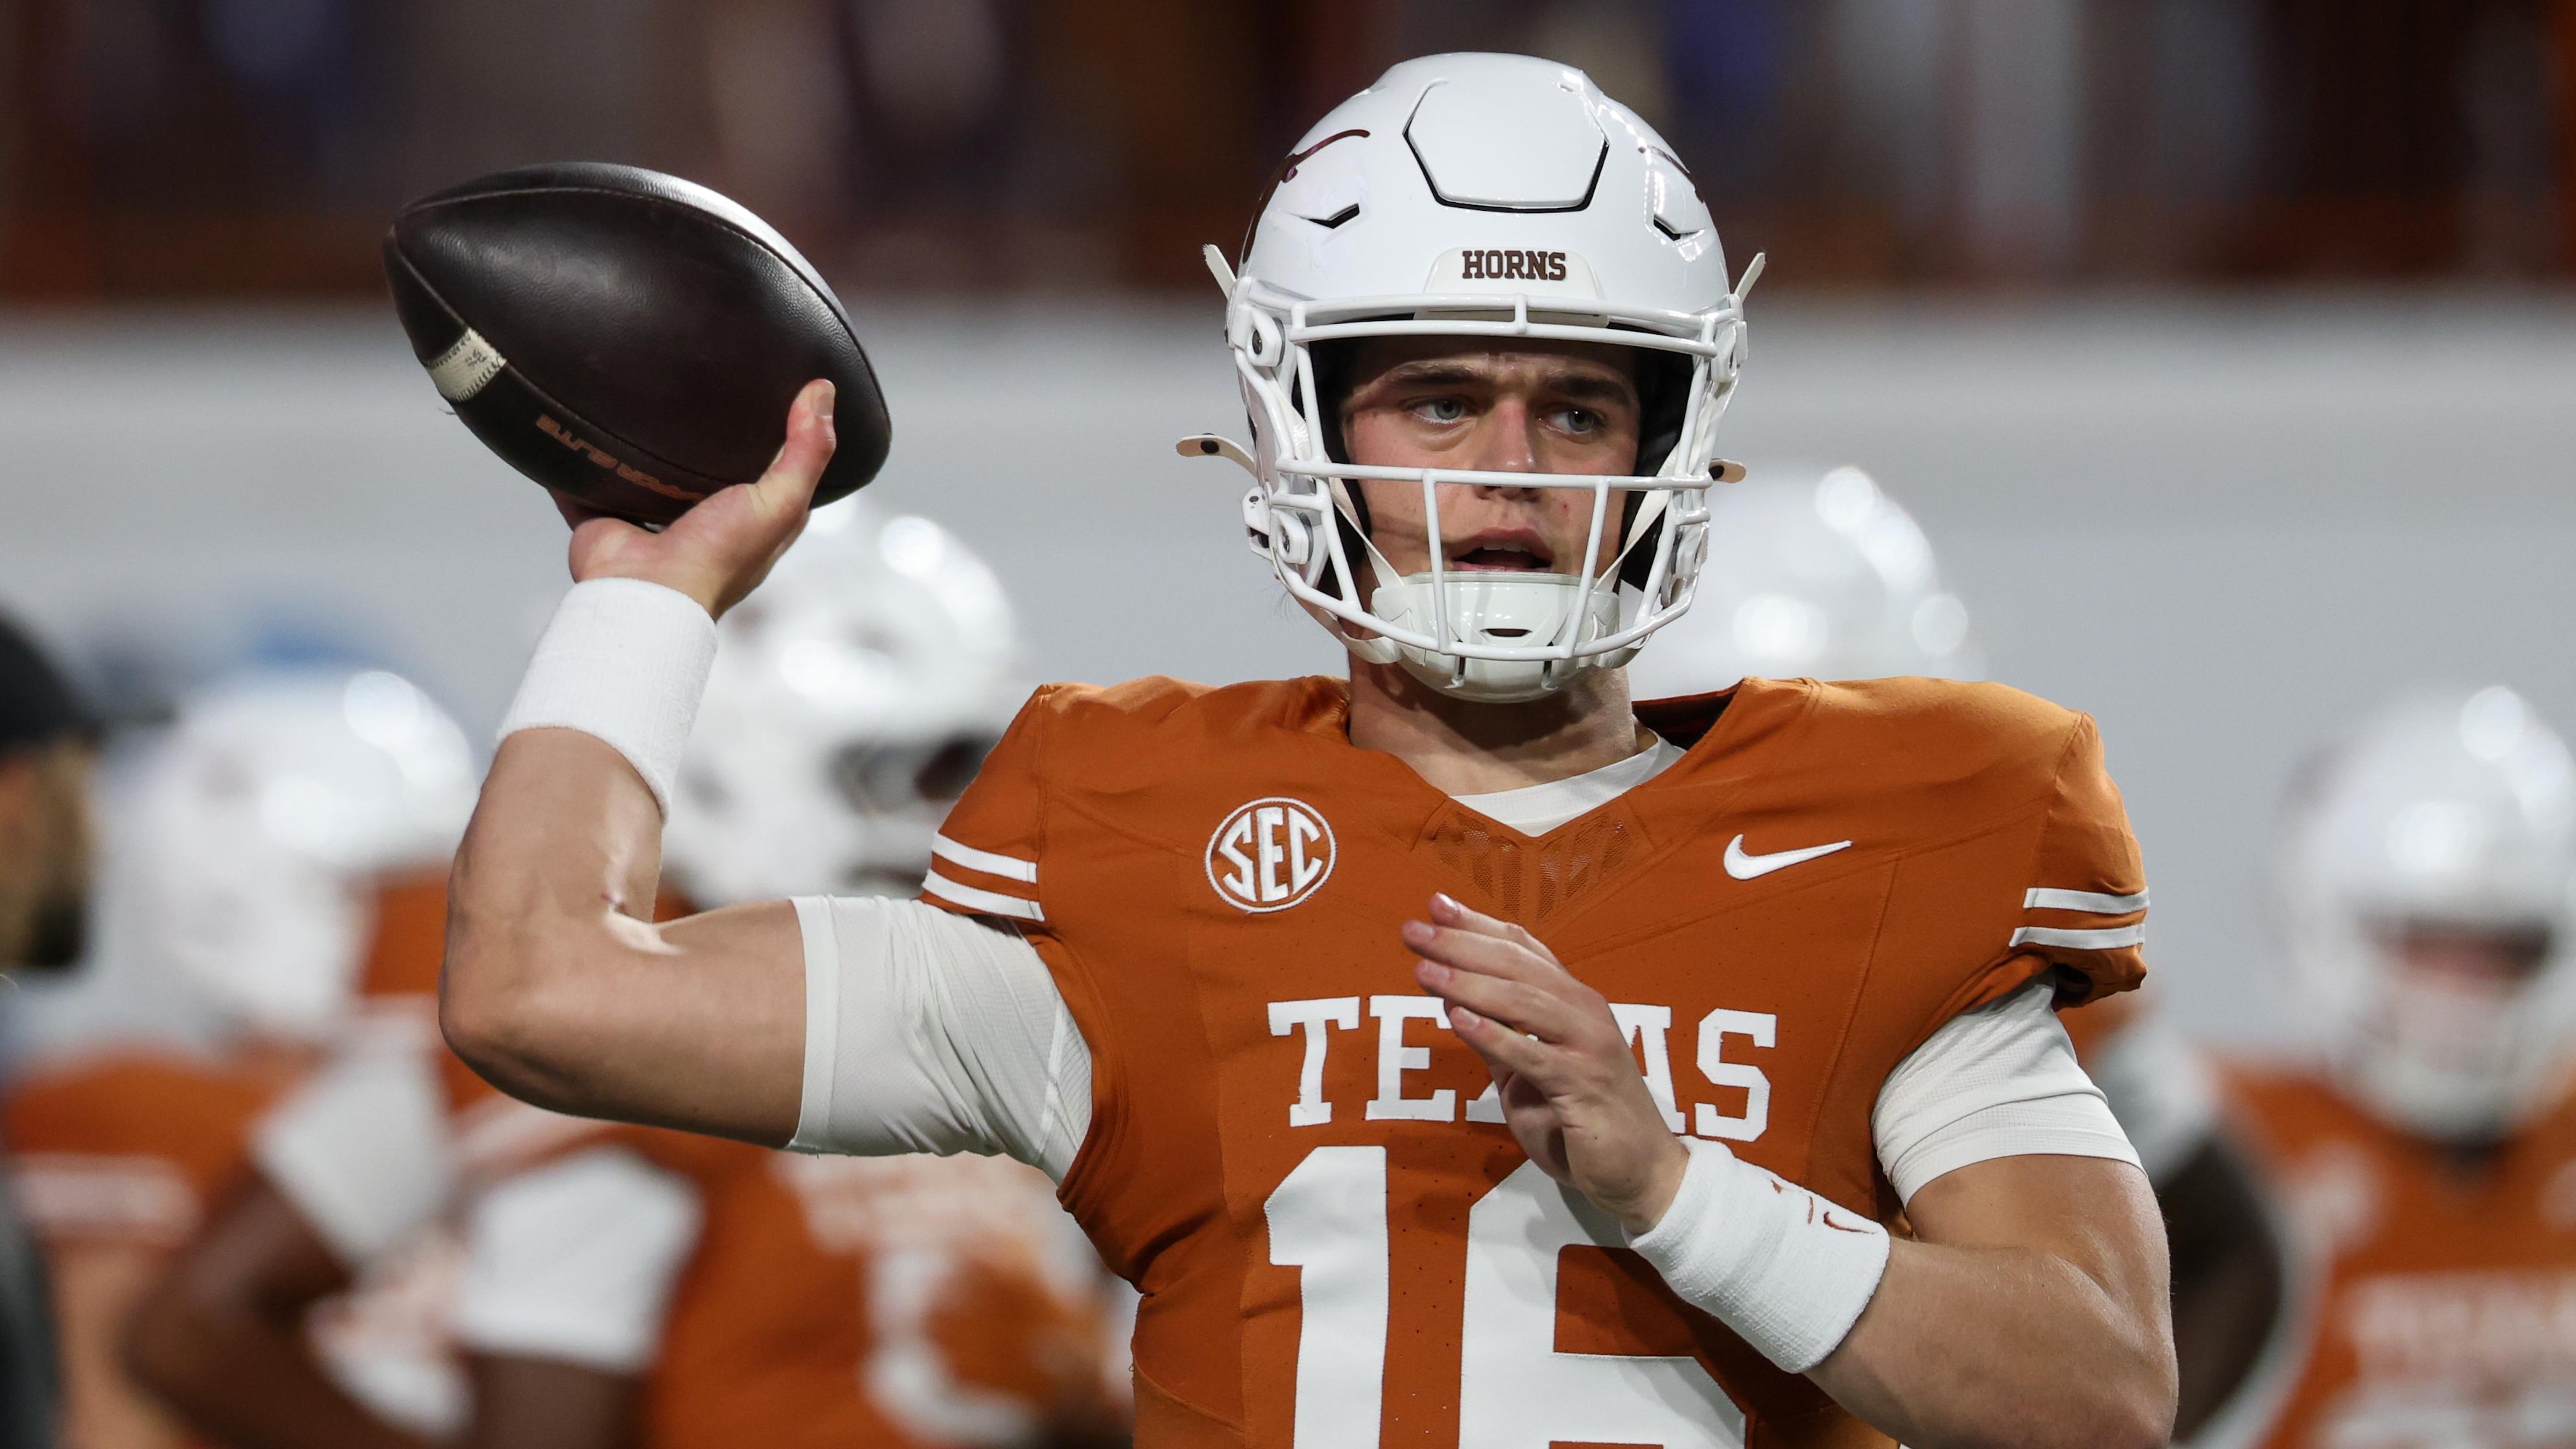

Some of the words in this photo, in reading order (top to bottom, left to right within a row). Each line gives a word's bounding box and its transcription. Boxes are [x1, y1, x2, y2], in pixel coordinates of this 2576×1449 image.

[1462, 250, 1566, 280] HORNS
[536, 414, 617, 469] ELITE
[1219, 806, 1323, 902] SEC
[1267, 995, 1777, 1142] TEAS
